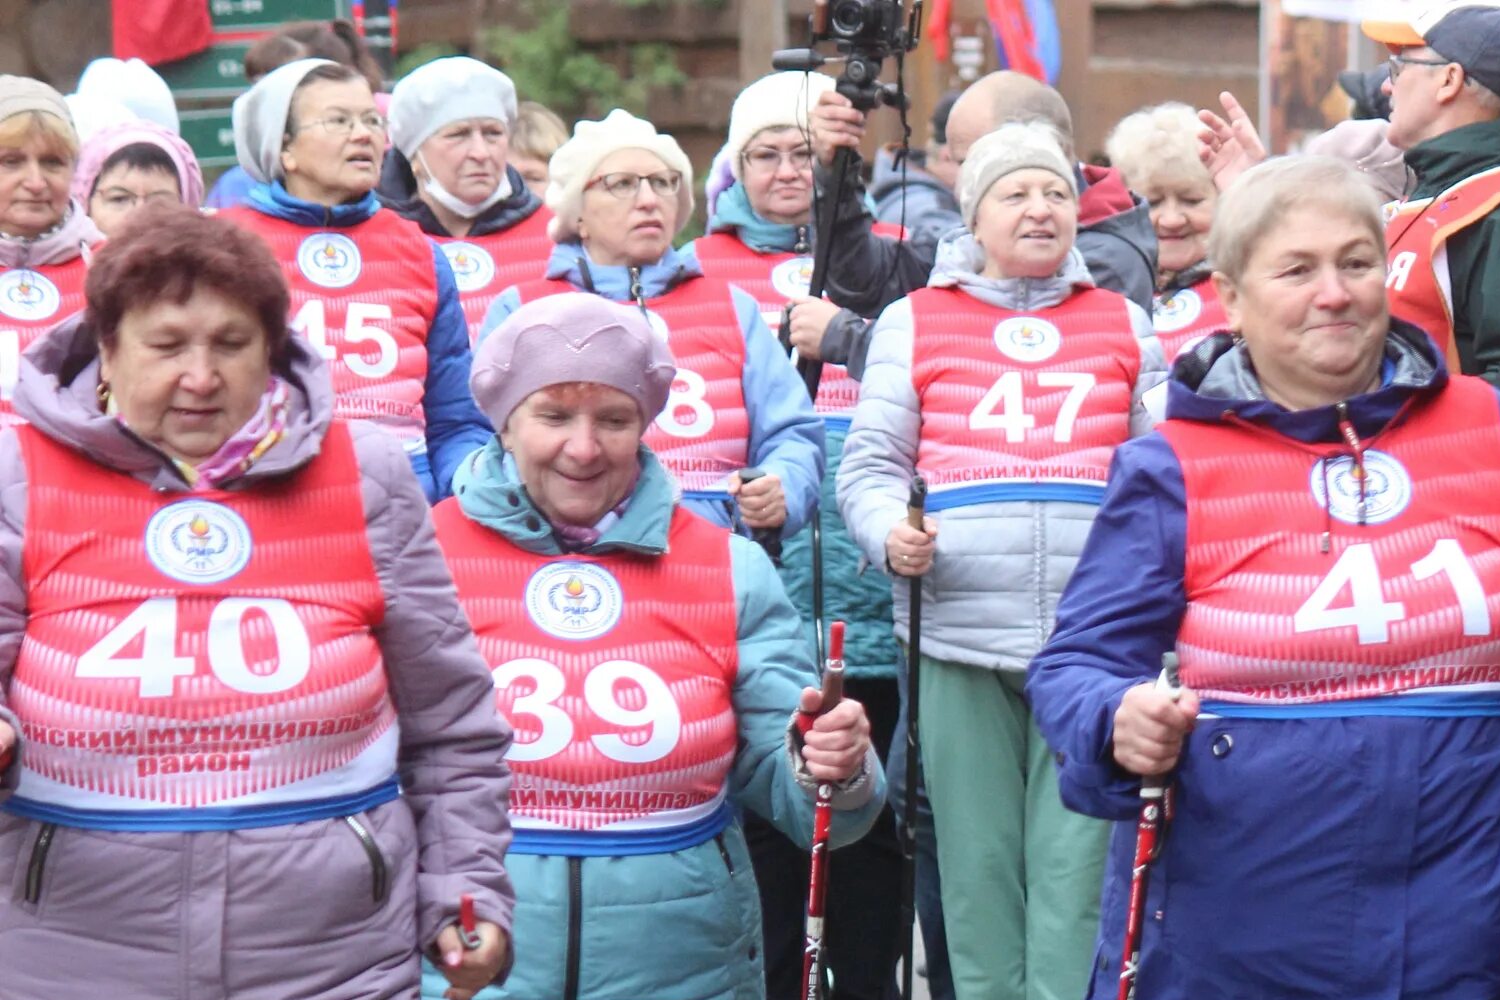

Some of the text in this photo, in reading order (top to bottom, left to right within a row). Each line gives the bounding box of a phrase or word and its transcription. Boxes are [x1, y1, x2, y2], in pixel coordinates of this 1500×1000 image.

[1384, 251, 1417, 291] Я
[290, 299, 399, 379] 45
[653, 367, 715, 438] 8
[968, 370, 1096, 444] 47
[1292, 538, 1491, 646] 41
[75, 596, 311, 698] 40
[23, 724, 137, 749] инский
[490, 657, 681, 764] 39
[137, 749, 251, 778] район
